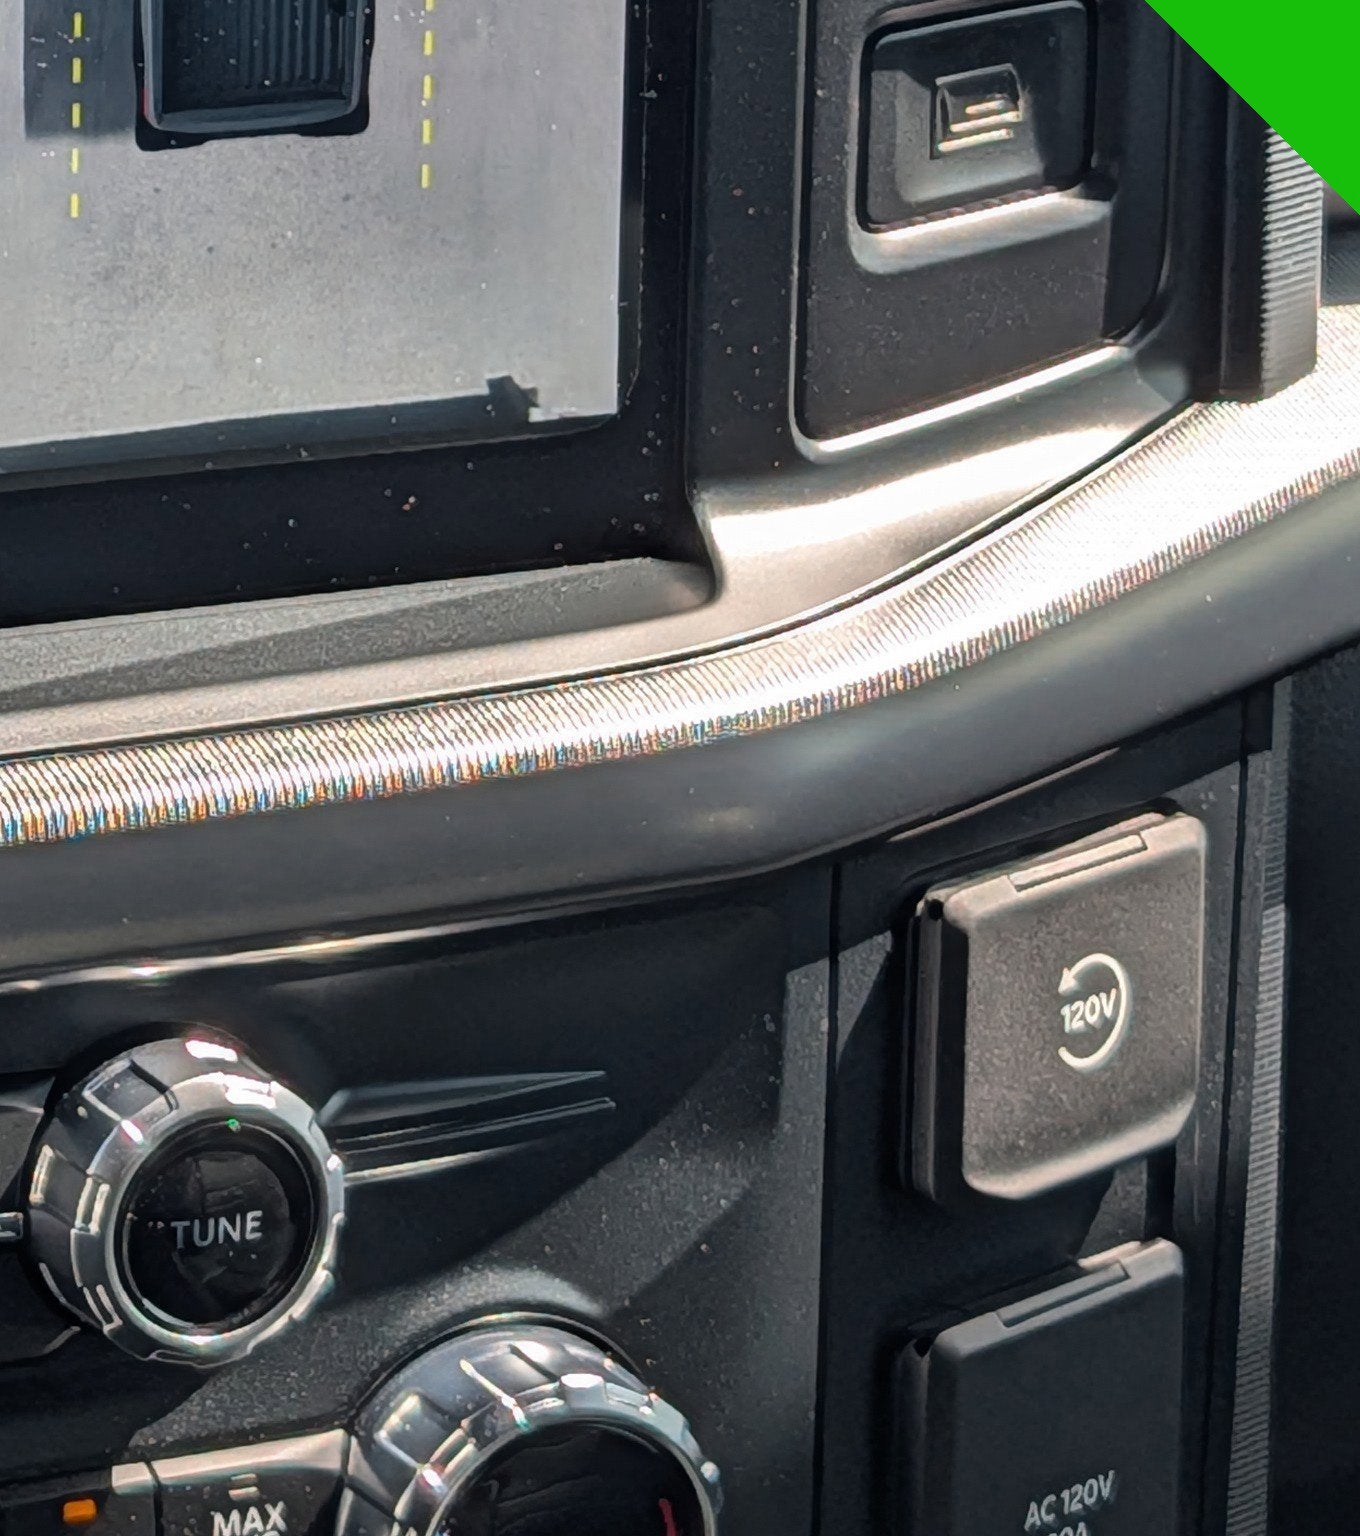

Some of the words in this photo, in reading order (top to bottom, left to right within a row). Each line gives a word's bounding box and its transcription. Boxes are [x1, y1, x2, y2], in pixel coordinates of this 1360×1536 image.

[1060, 987, 1118, 1034] 120V
[170, 1209, 264, 1250] TUNE
[209, 1500, 288, 1536] MAX
[1023, 1493, 1057, 1532] AC
[1059, 1469, 1116, 1516] 120V
